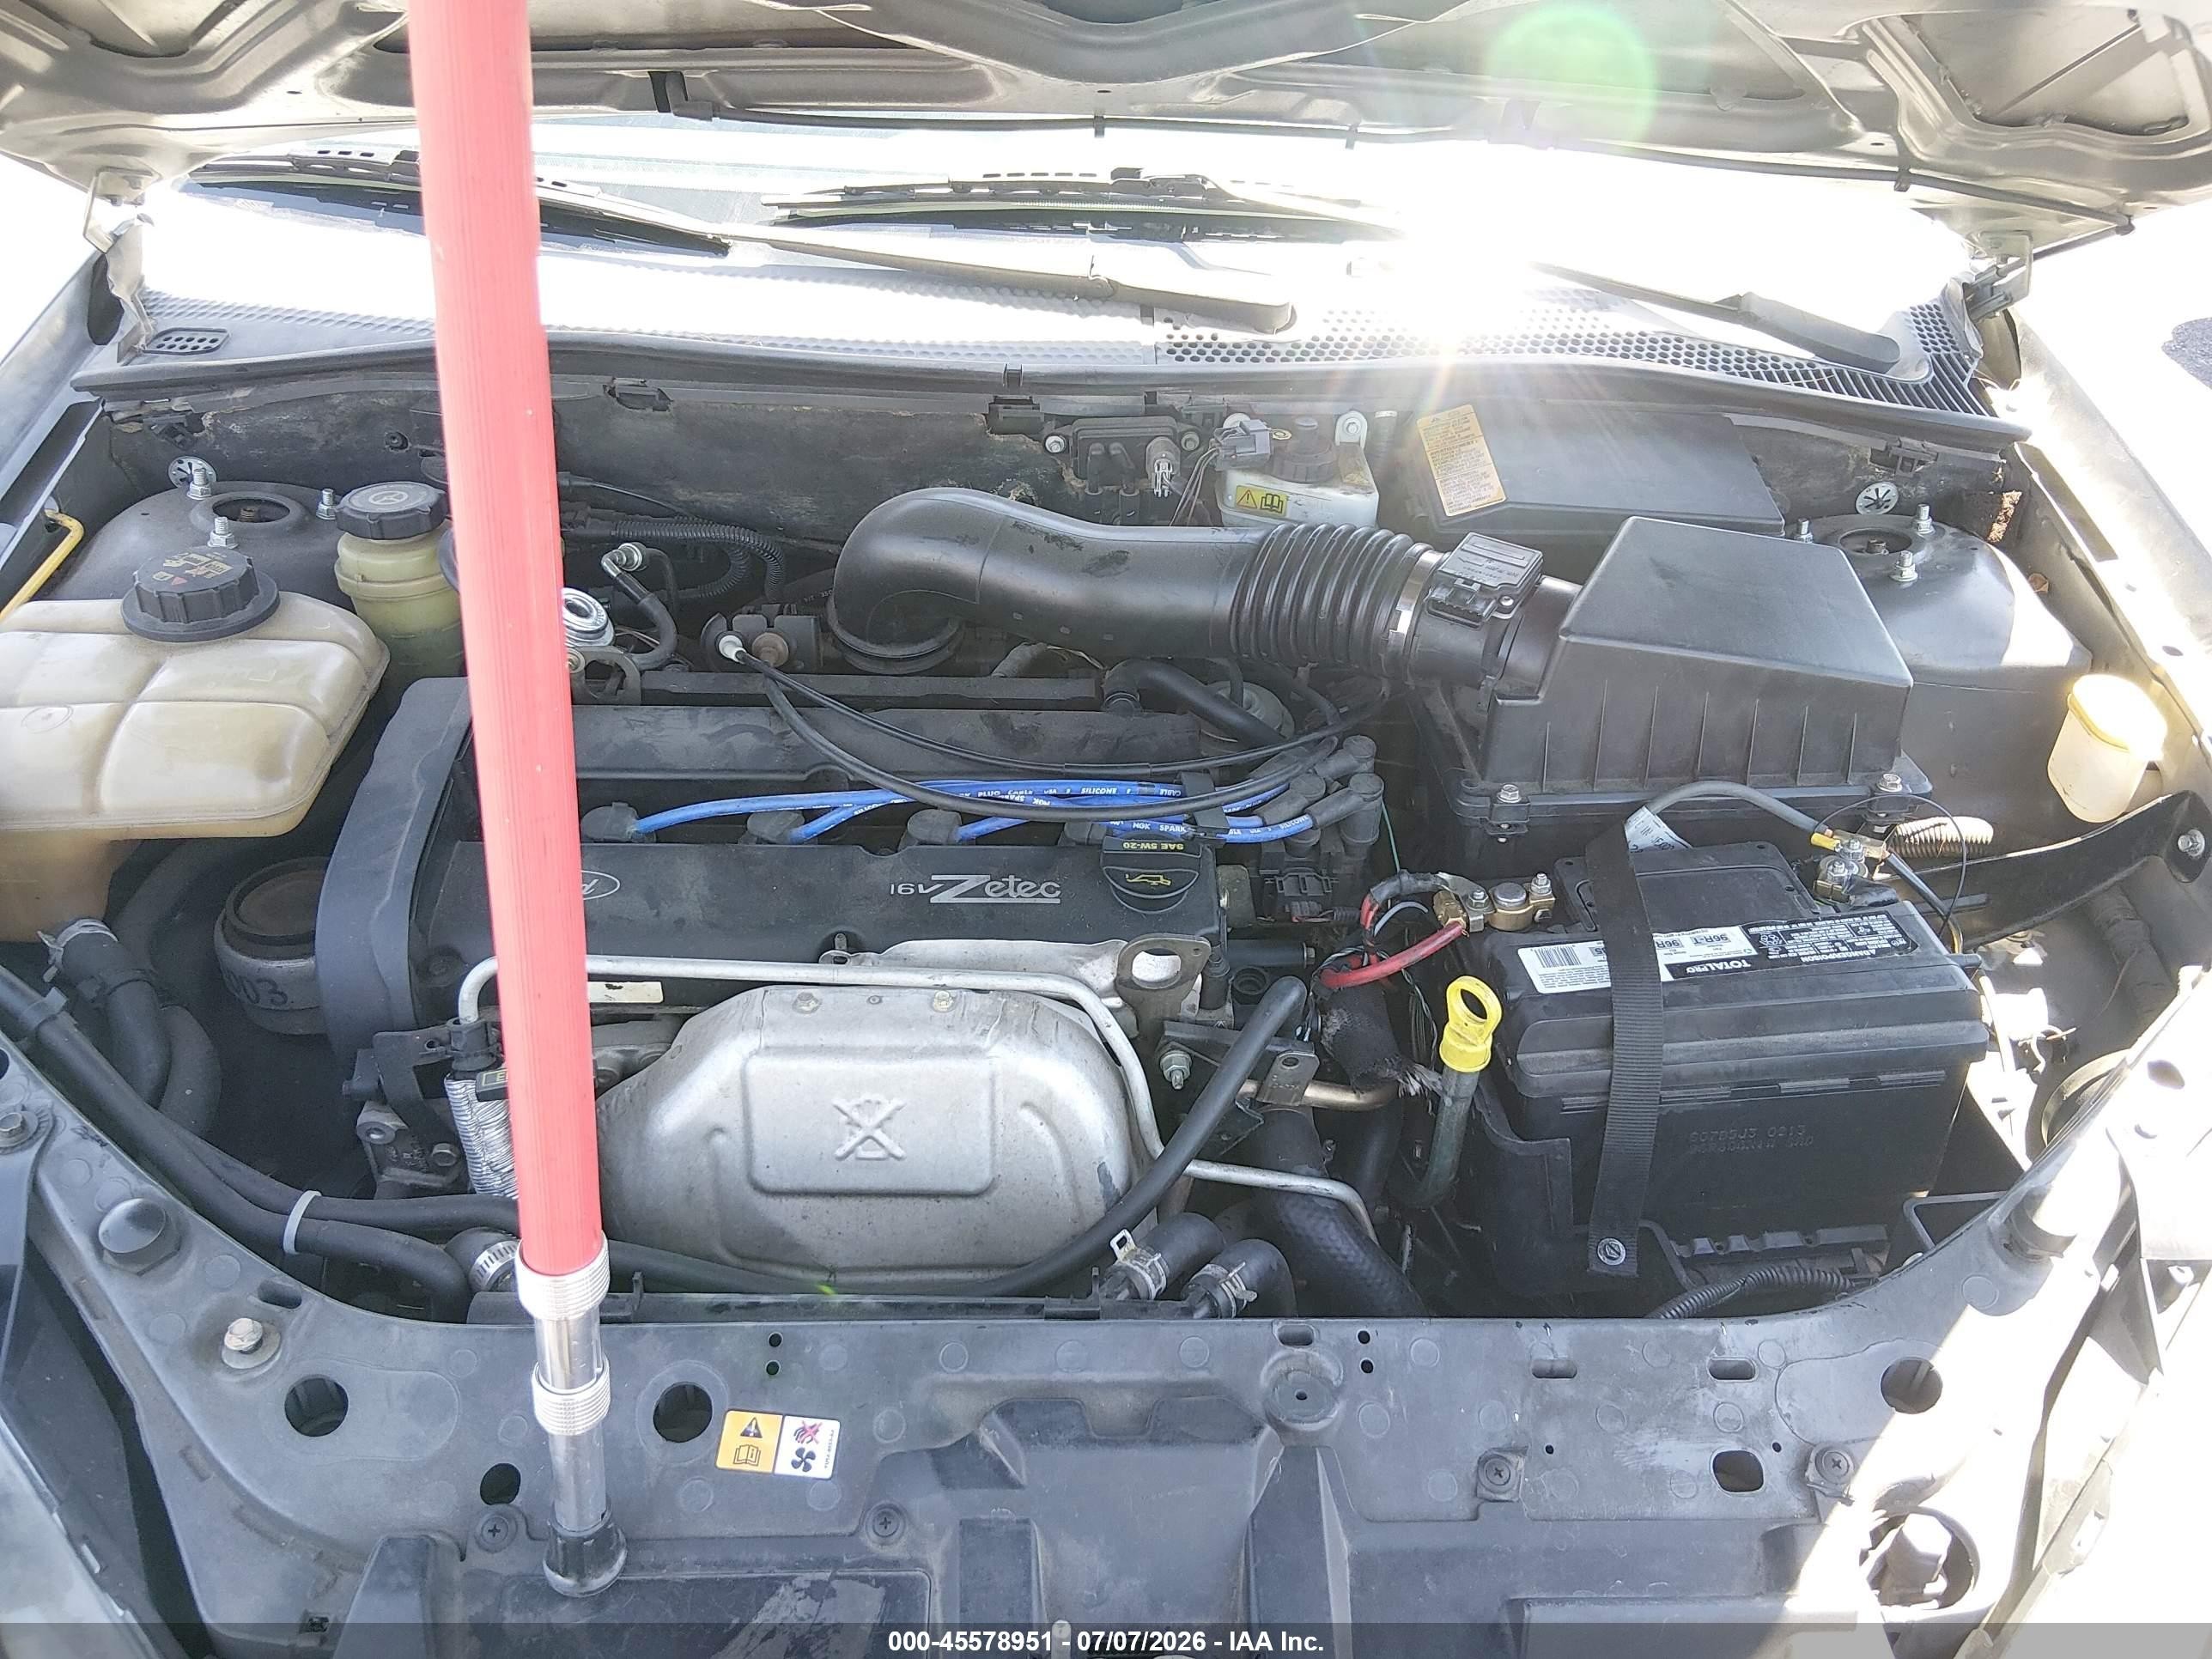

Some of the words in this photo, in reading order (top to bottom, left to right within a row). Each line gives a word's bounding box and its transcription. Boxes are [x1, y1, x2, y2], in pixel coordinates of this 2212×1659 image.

[1133, 821, 1152, 830] NGK
[1122, 842, 1158, 850] 5W-20
[1160, 842, 1185, 850] SAE
[890, 883, 945, 895] 16V
[930, 874, 1060, 903] Zetec
[1693, 933, 1729, 945] 96R-T
[1686, 959, 1752, 974] TOTALPRO
